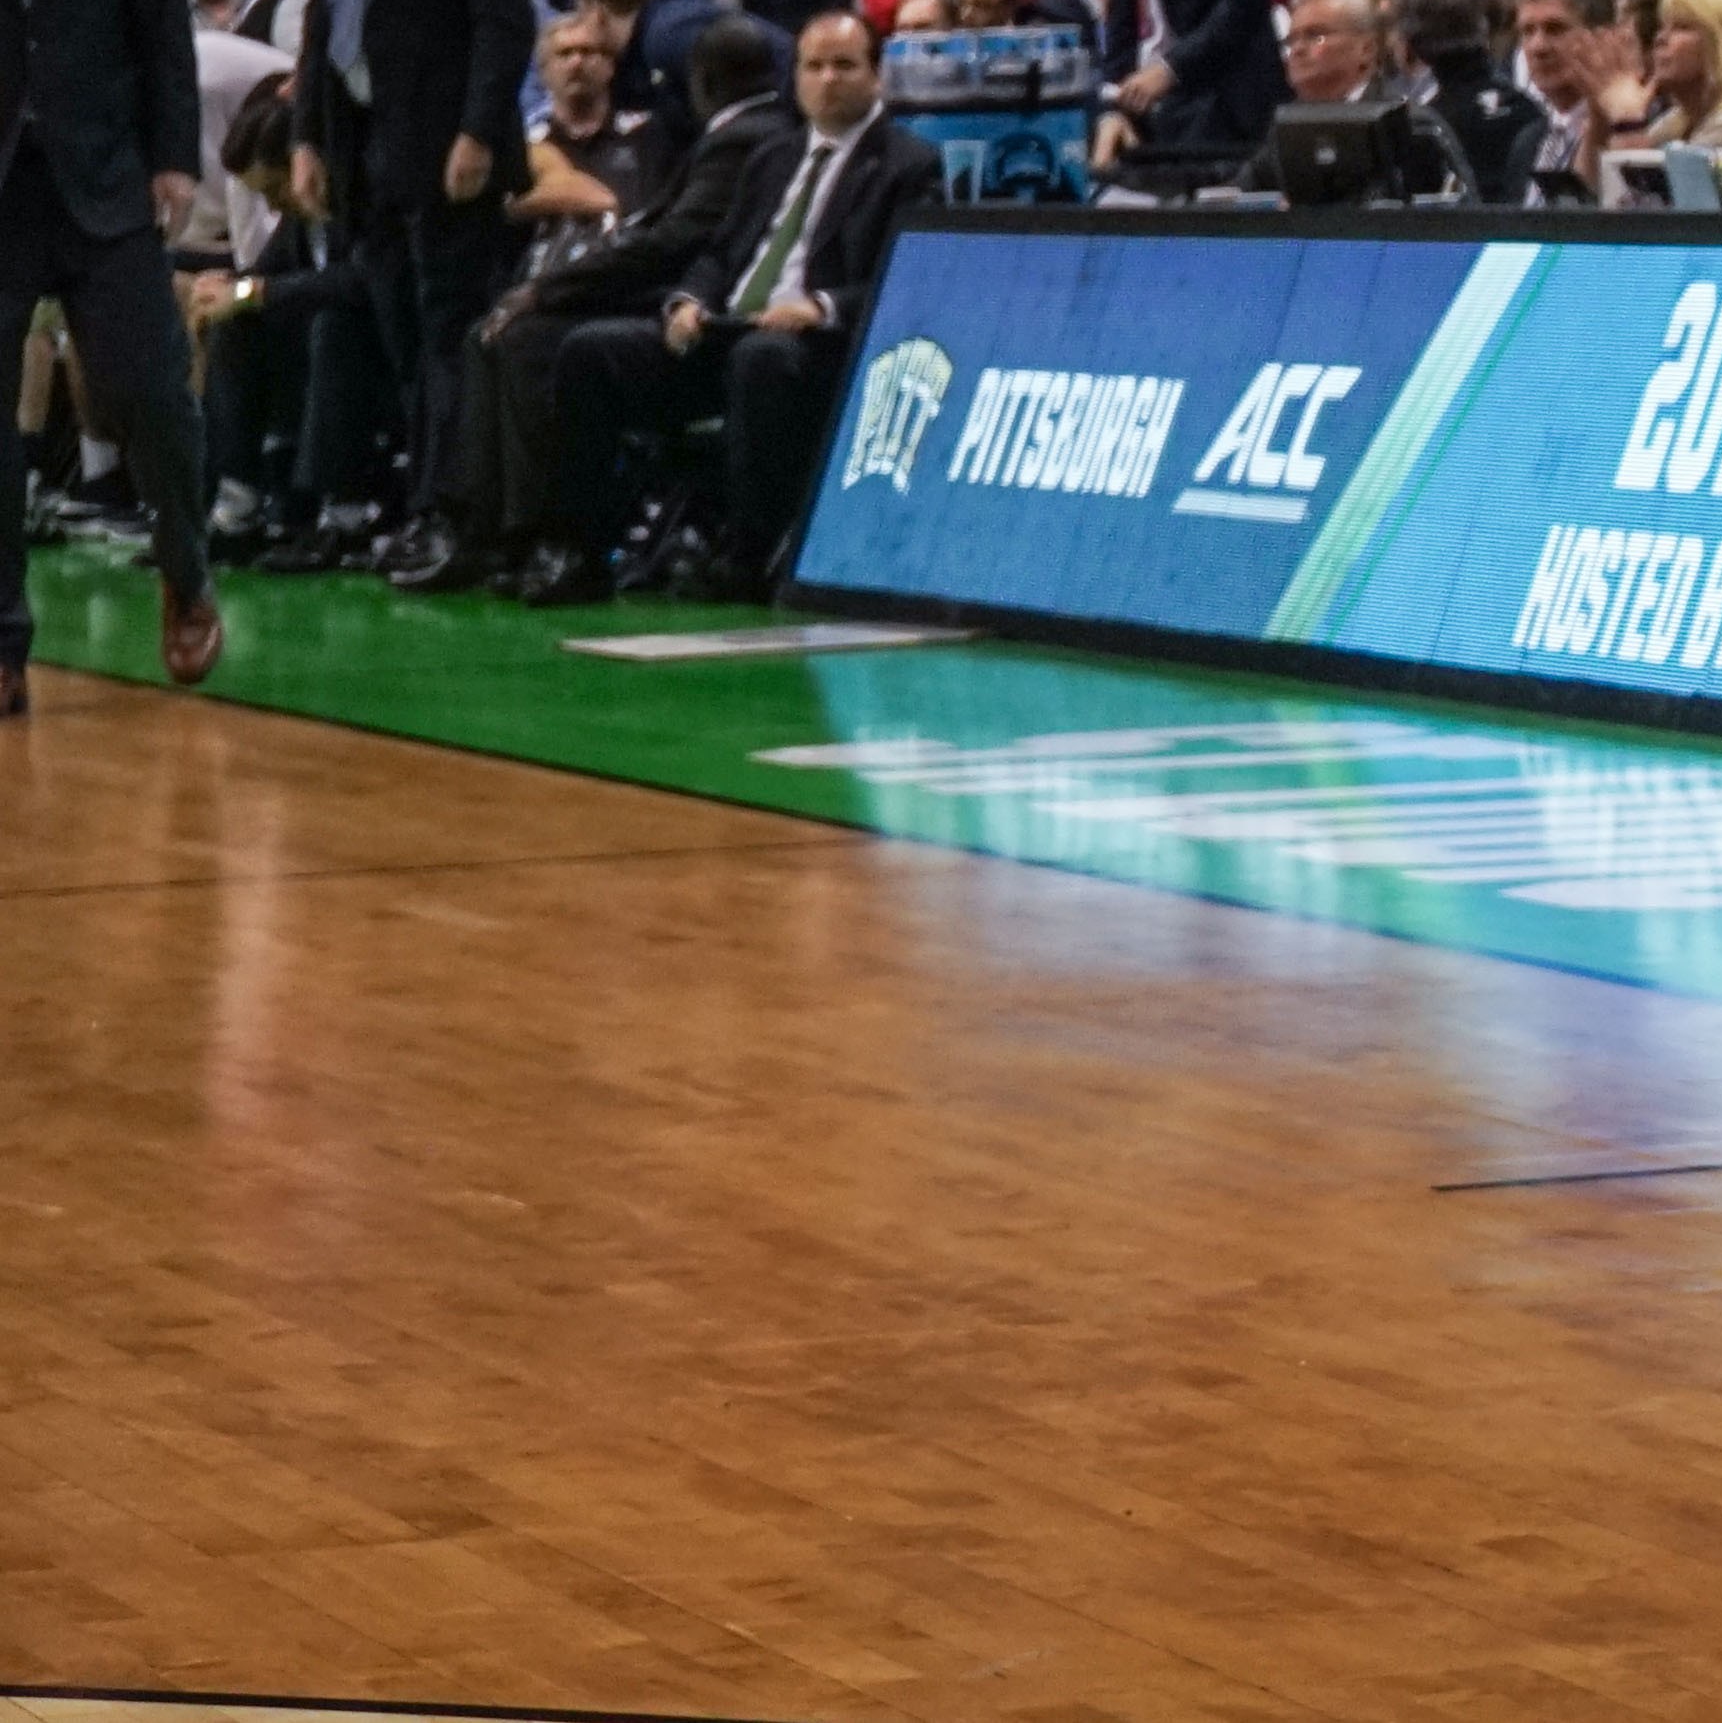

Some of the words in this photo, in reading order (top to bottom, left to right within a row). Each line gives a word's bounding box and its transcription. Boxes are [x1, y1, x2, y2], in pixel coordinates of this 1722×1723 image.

[947, 367, 1186, 498] PITTSBURGH
[1194, 362, 1363, 492] ACC
[1511, 524, 1706, 666] HOSTED
